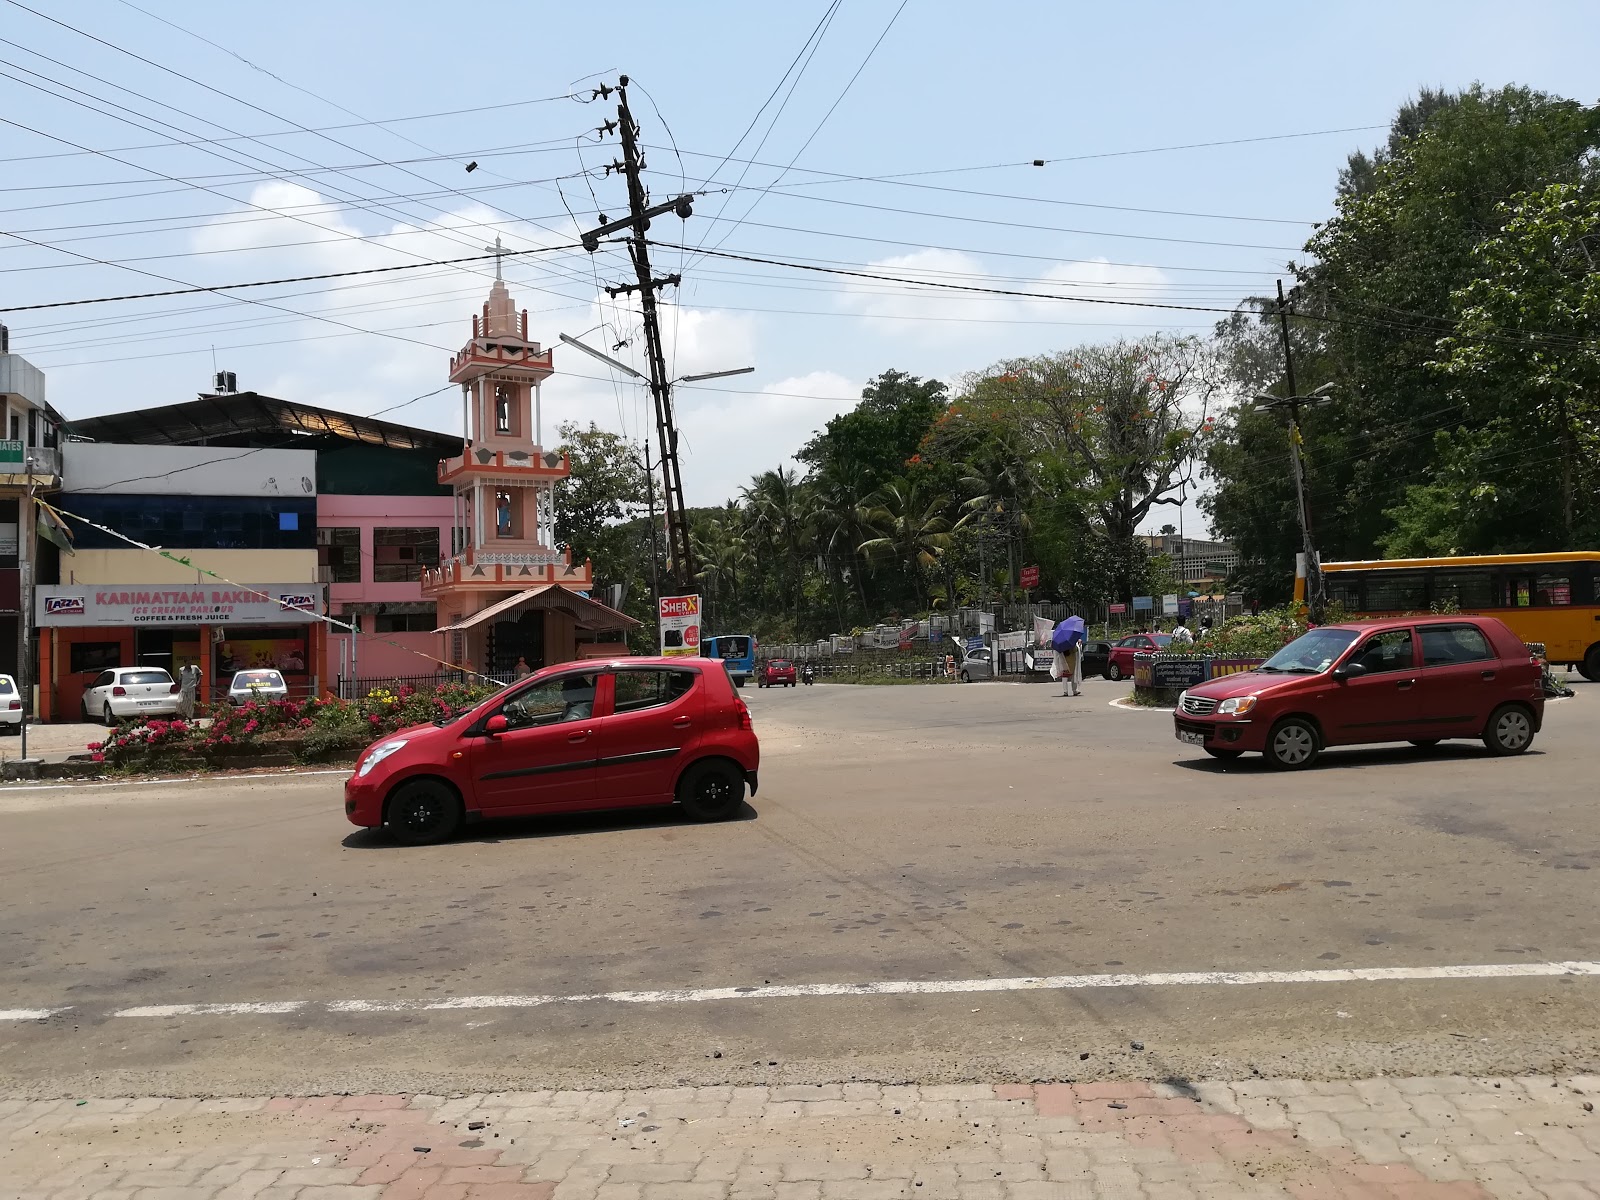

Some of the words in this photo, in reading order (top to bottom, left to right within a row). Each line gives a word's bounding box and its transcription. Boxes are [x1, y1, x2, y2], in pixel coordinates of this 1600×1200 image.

[47, 598, 80, 611] LAZZA
[96, 592, 205, 605] KARIMATTAM
[212, 591, 270, 604] BAKERS
[132, 606, 148, 614] ICE
[151, 606, 186, 614] CREAM
[189, 605, 235, 614] PARLOUR
